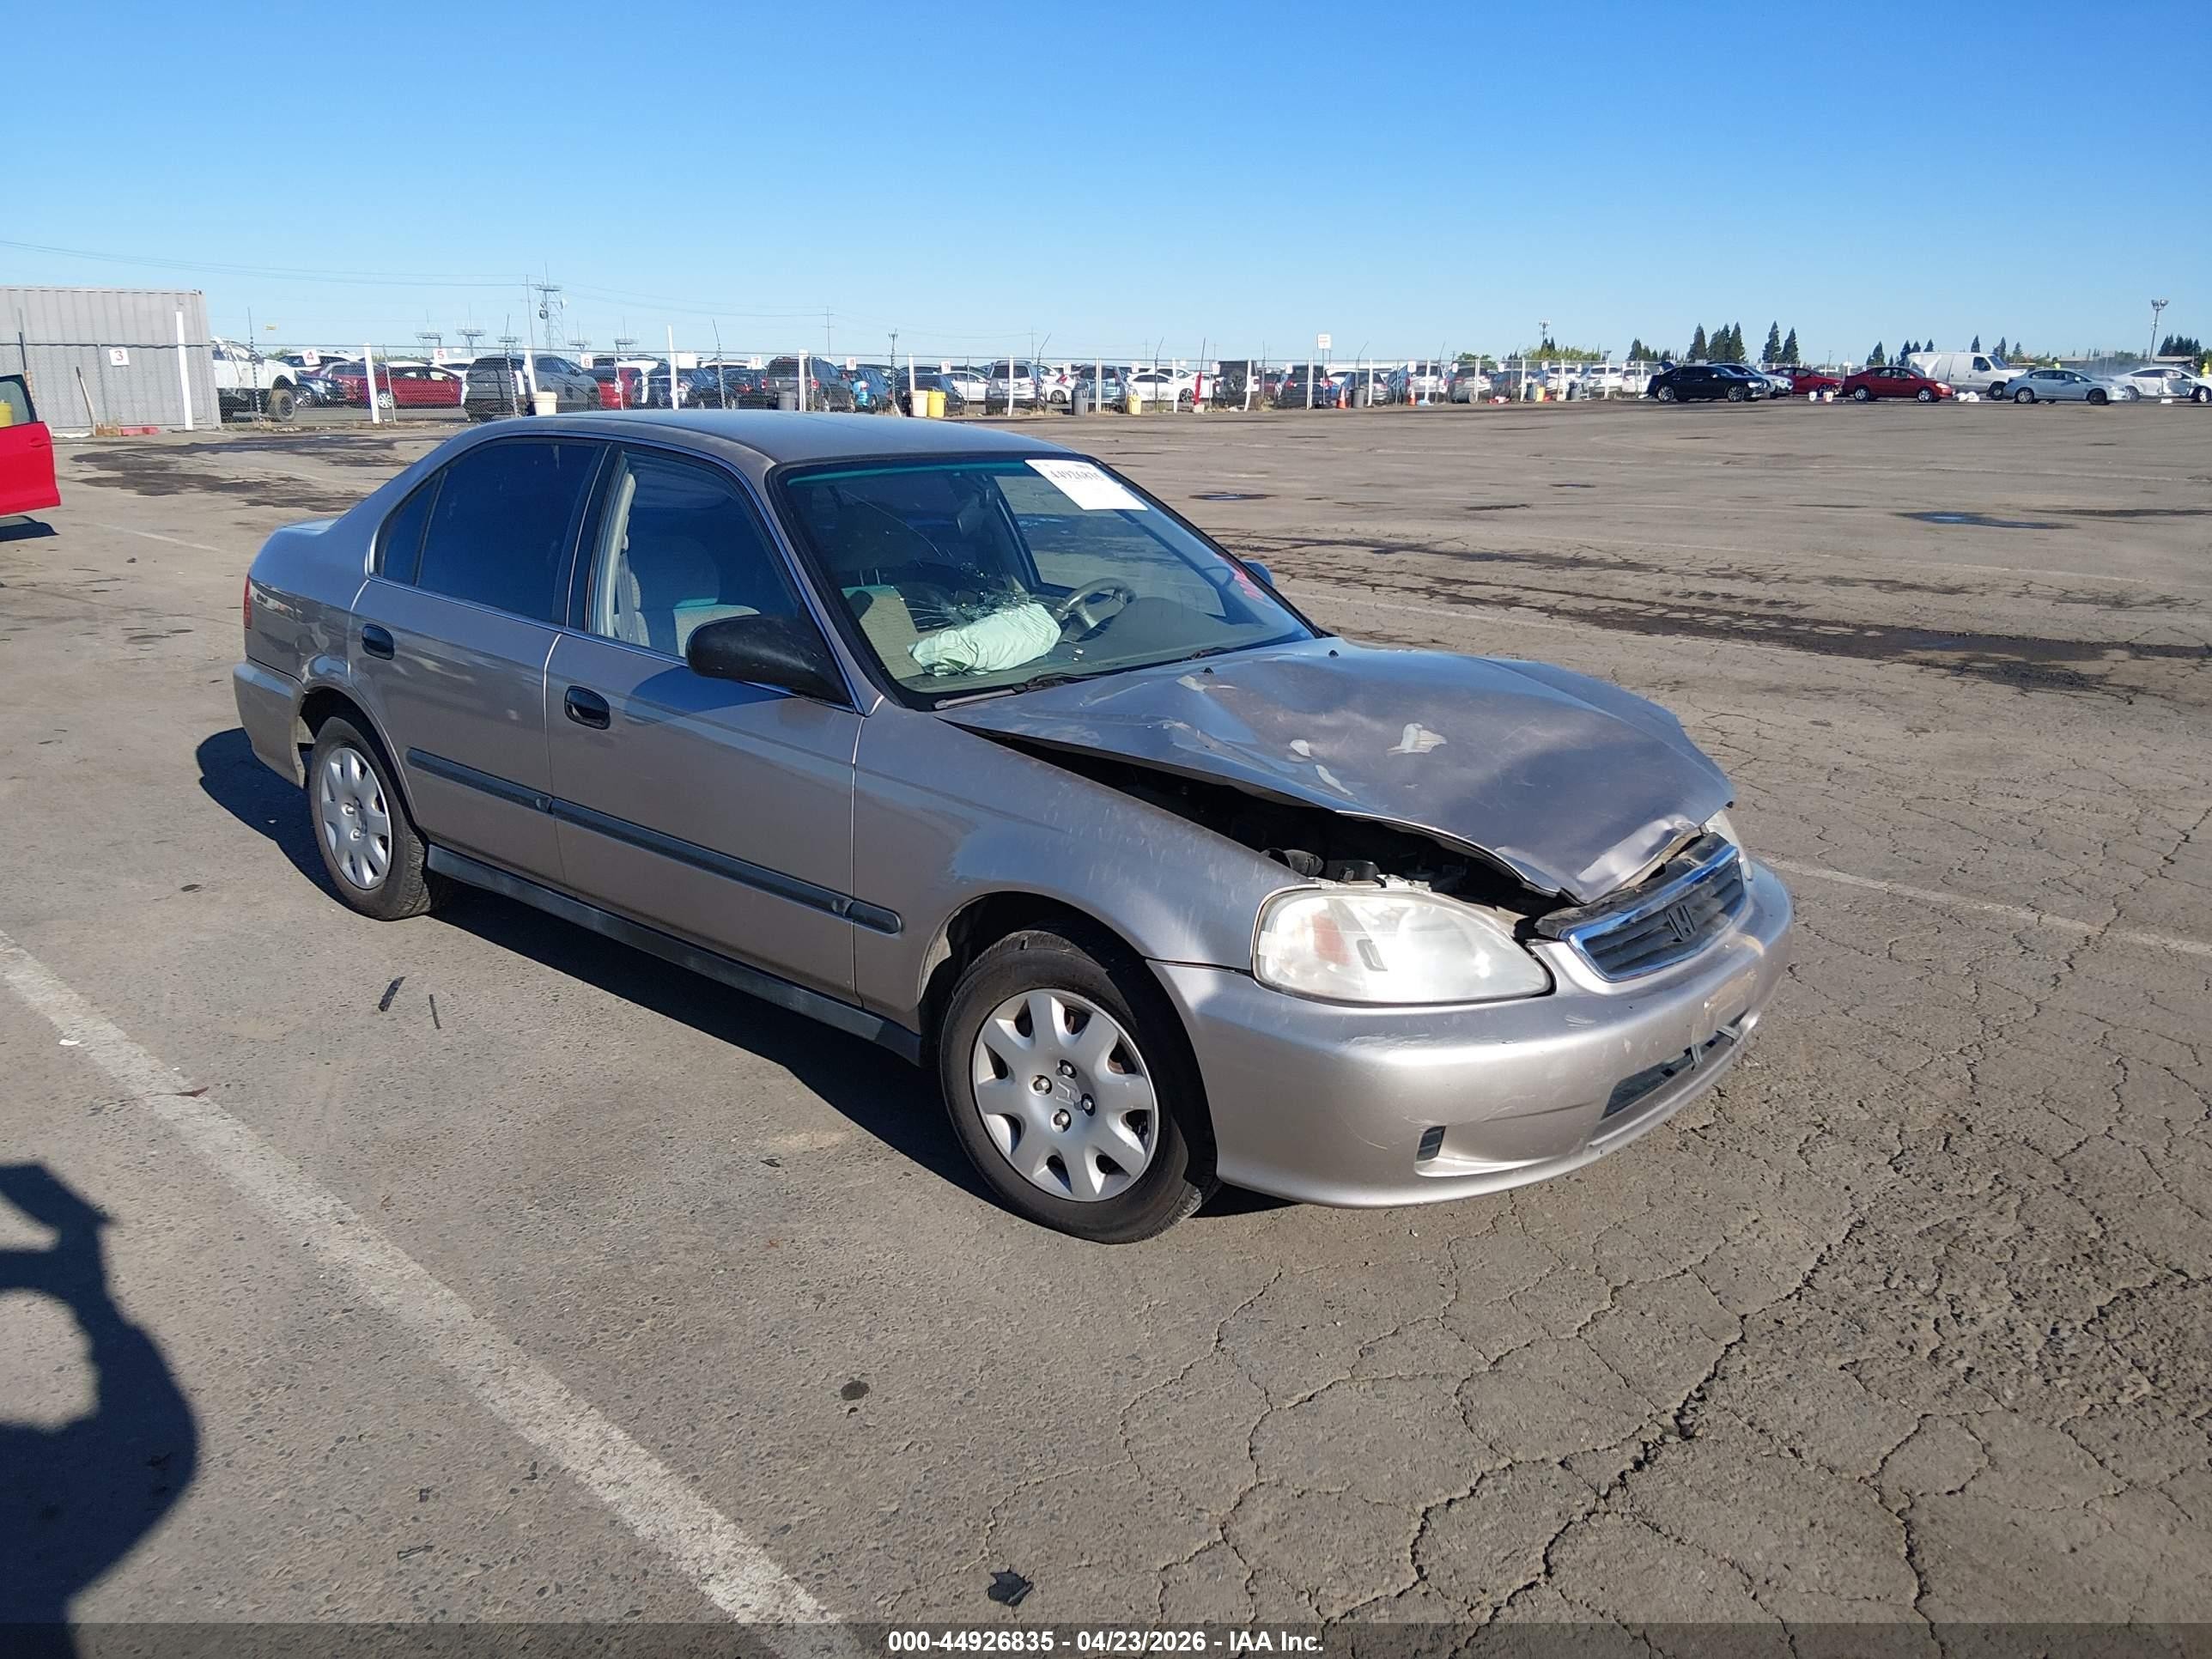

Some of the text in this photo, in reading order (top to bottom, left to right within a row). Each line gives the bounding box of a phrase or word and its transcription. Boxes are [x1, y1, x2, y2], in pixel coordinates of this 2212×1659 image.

[114, 349, 124, 362] 3
[307, 351, 314, 360] 4
[437, 350, 445, 360] 5
[584, 358, 590, 368] 6
[753, 357, 759, 366] 7
[849, 359, 855, 368] 8
